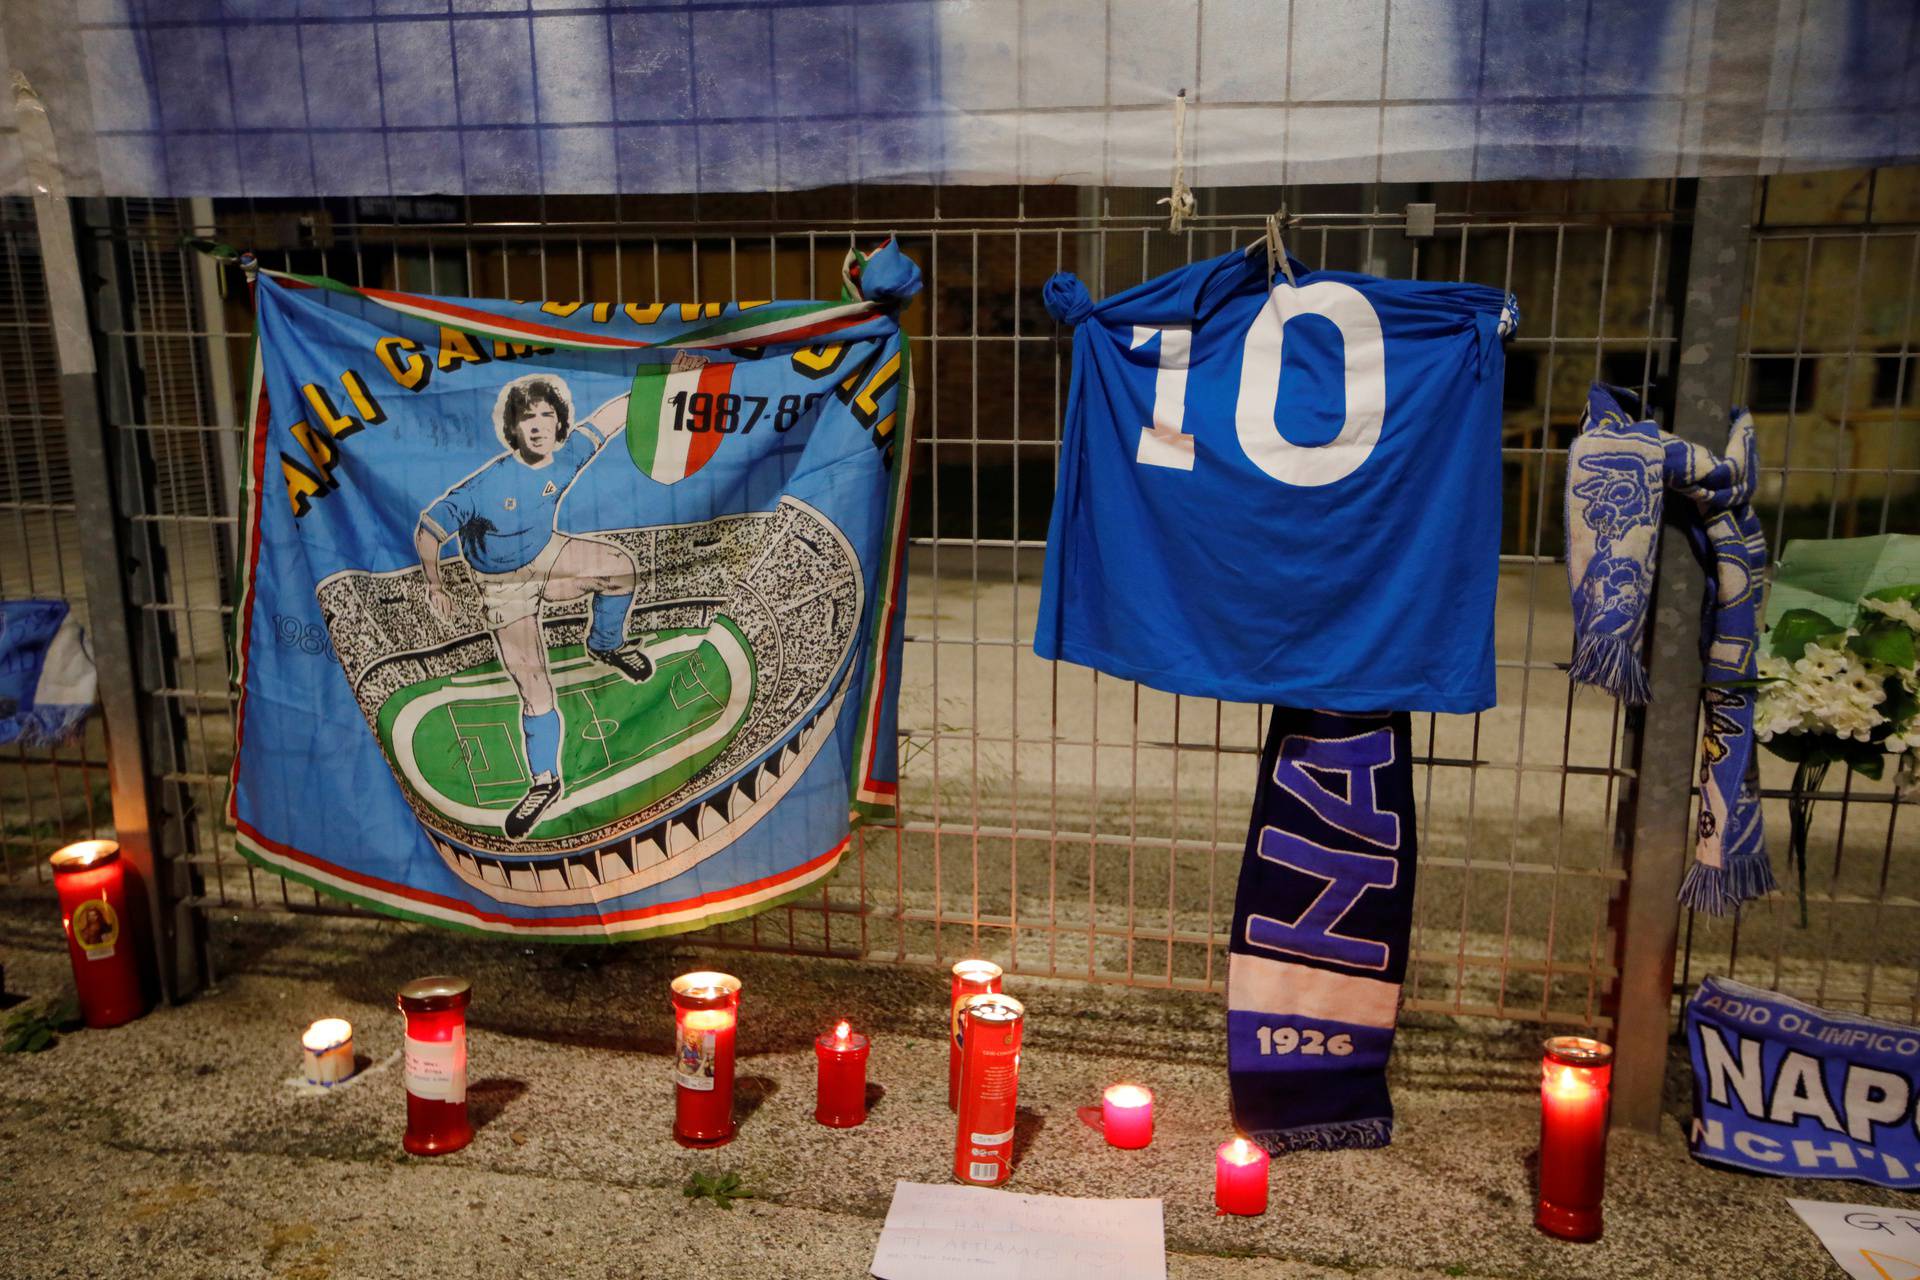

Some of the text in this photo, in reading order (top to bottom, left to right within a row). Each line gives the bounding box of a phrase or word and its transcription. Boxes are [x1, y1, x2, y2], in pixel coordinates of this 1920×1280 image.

[1130, 281, 1386, 487] 10
[1256, 1025, 1354, 1056] 1926
[1779, 1014, 1919, 1056] OLIMPICO
[1699, 1023, 1920, 1146] NAP
